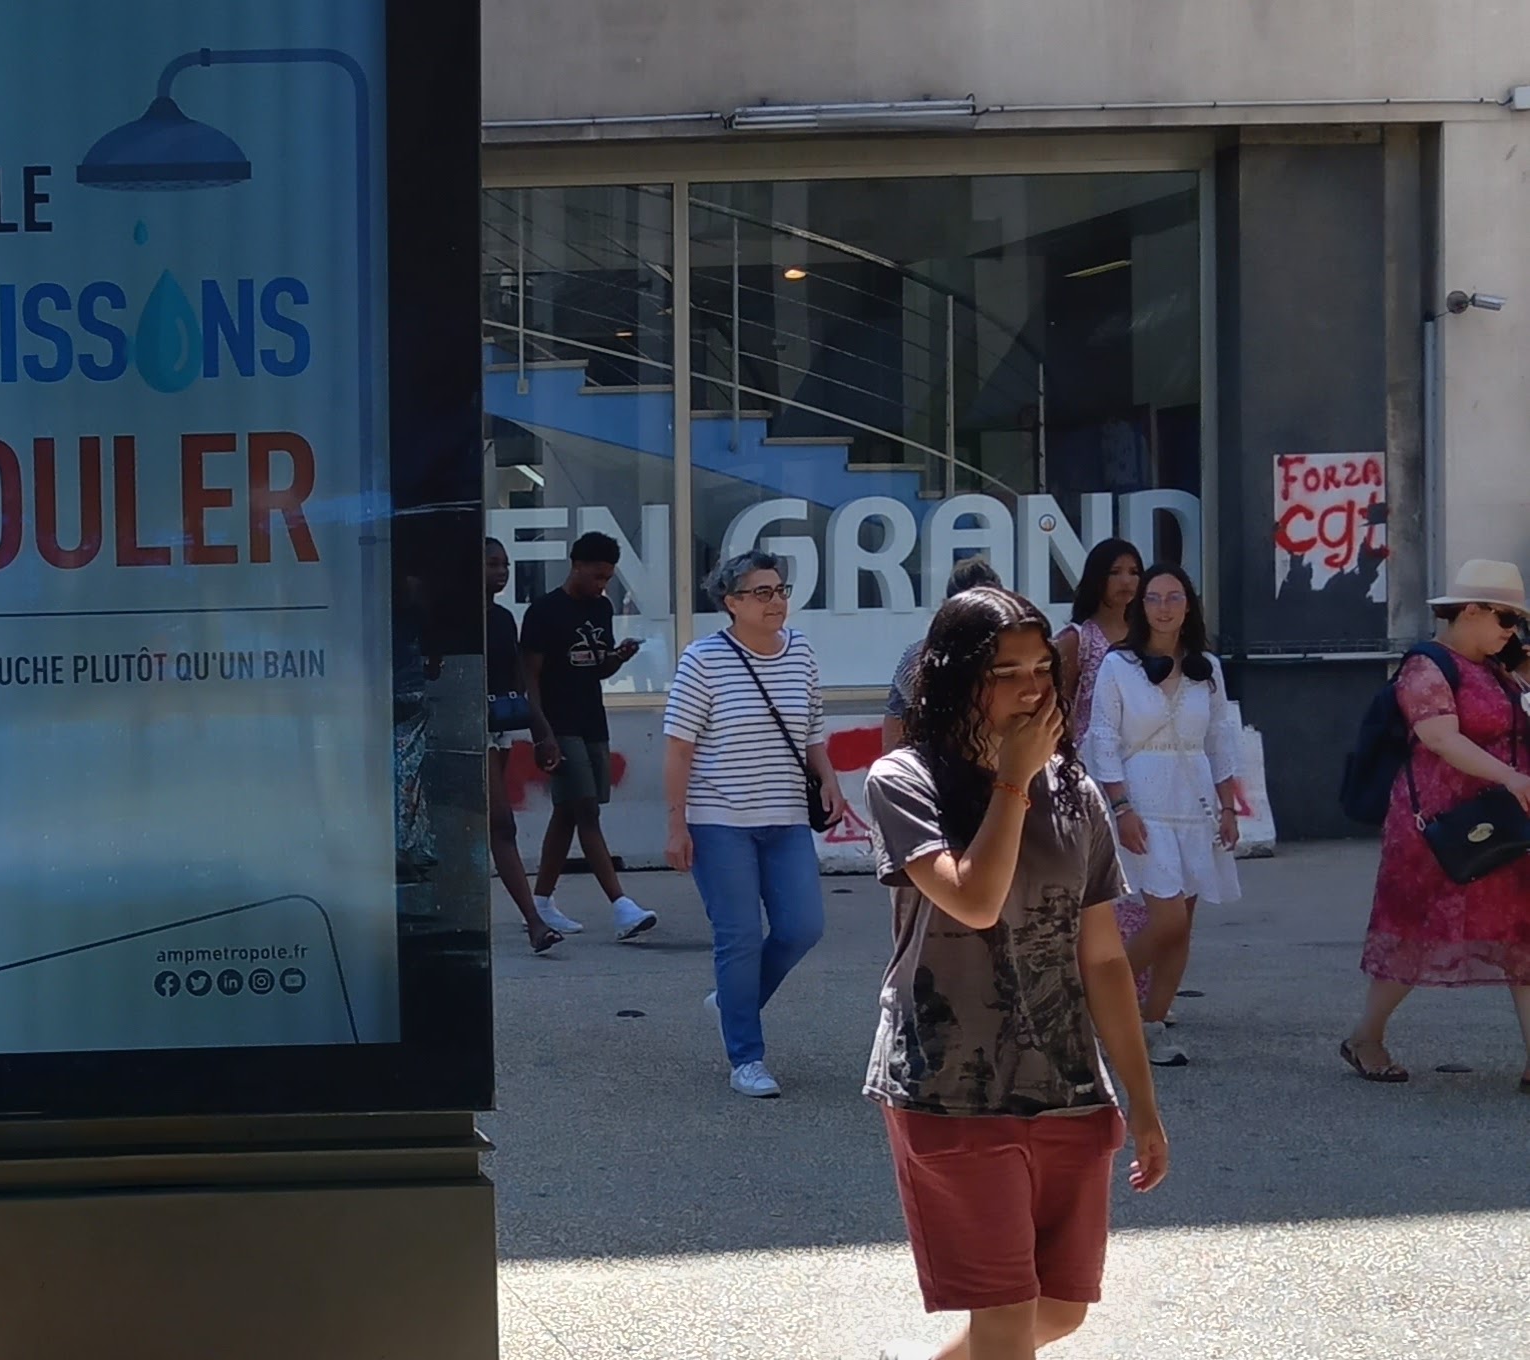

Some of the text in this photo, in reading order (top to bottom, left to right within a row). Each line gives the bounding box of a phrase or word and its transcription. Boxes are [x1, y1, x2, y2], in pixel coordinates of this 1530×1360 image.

[1276, 455, 1383, 501] FORZA
[73, 647, 168, 684] PLUTÔT
[175, 652, 254, 682] QU'UN
[264, 649, 326, 679] BAIN
[156, 944, 308, 966] ampmetropole.fr
